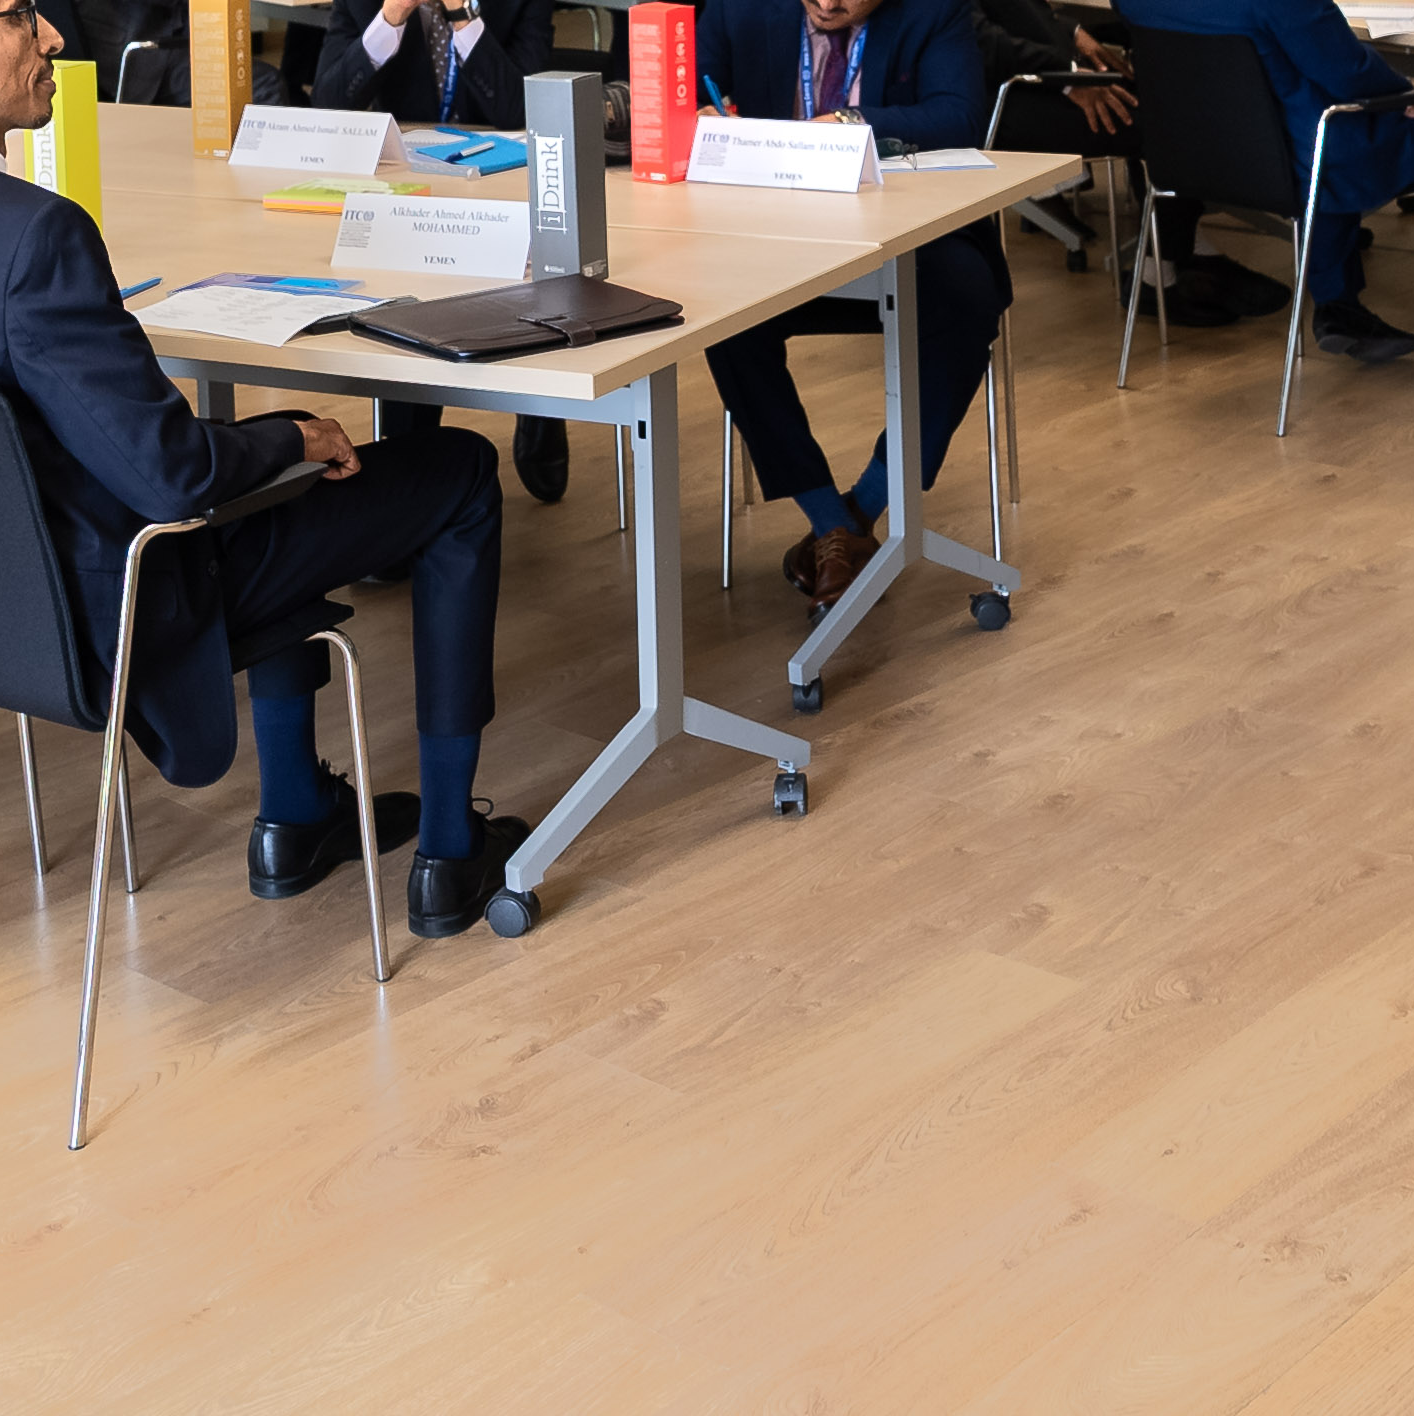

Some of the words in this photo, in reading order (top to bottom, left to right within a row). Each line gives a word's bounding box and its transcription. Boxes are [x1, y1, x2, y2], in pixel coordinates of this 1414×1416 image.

[342, 127, 378, 137] SALLAM
[300, 156, 325, 164] YEMEN
[774, 172, 803, 181] YEMEN
[389, 207, 431, 218] Alkhader
[432, 209, 466, 220] Ahmed
[466, 211, 510, 223] Alkhader
[412, 222, 481, 236] MOHAMMED
[424, 256, 456, 265] YEMEN
